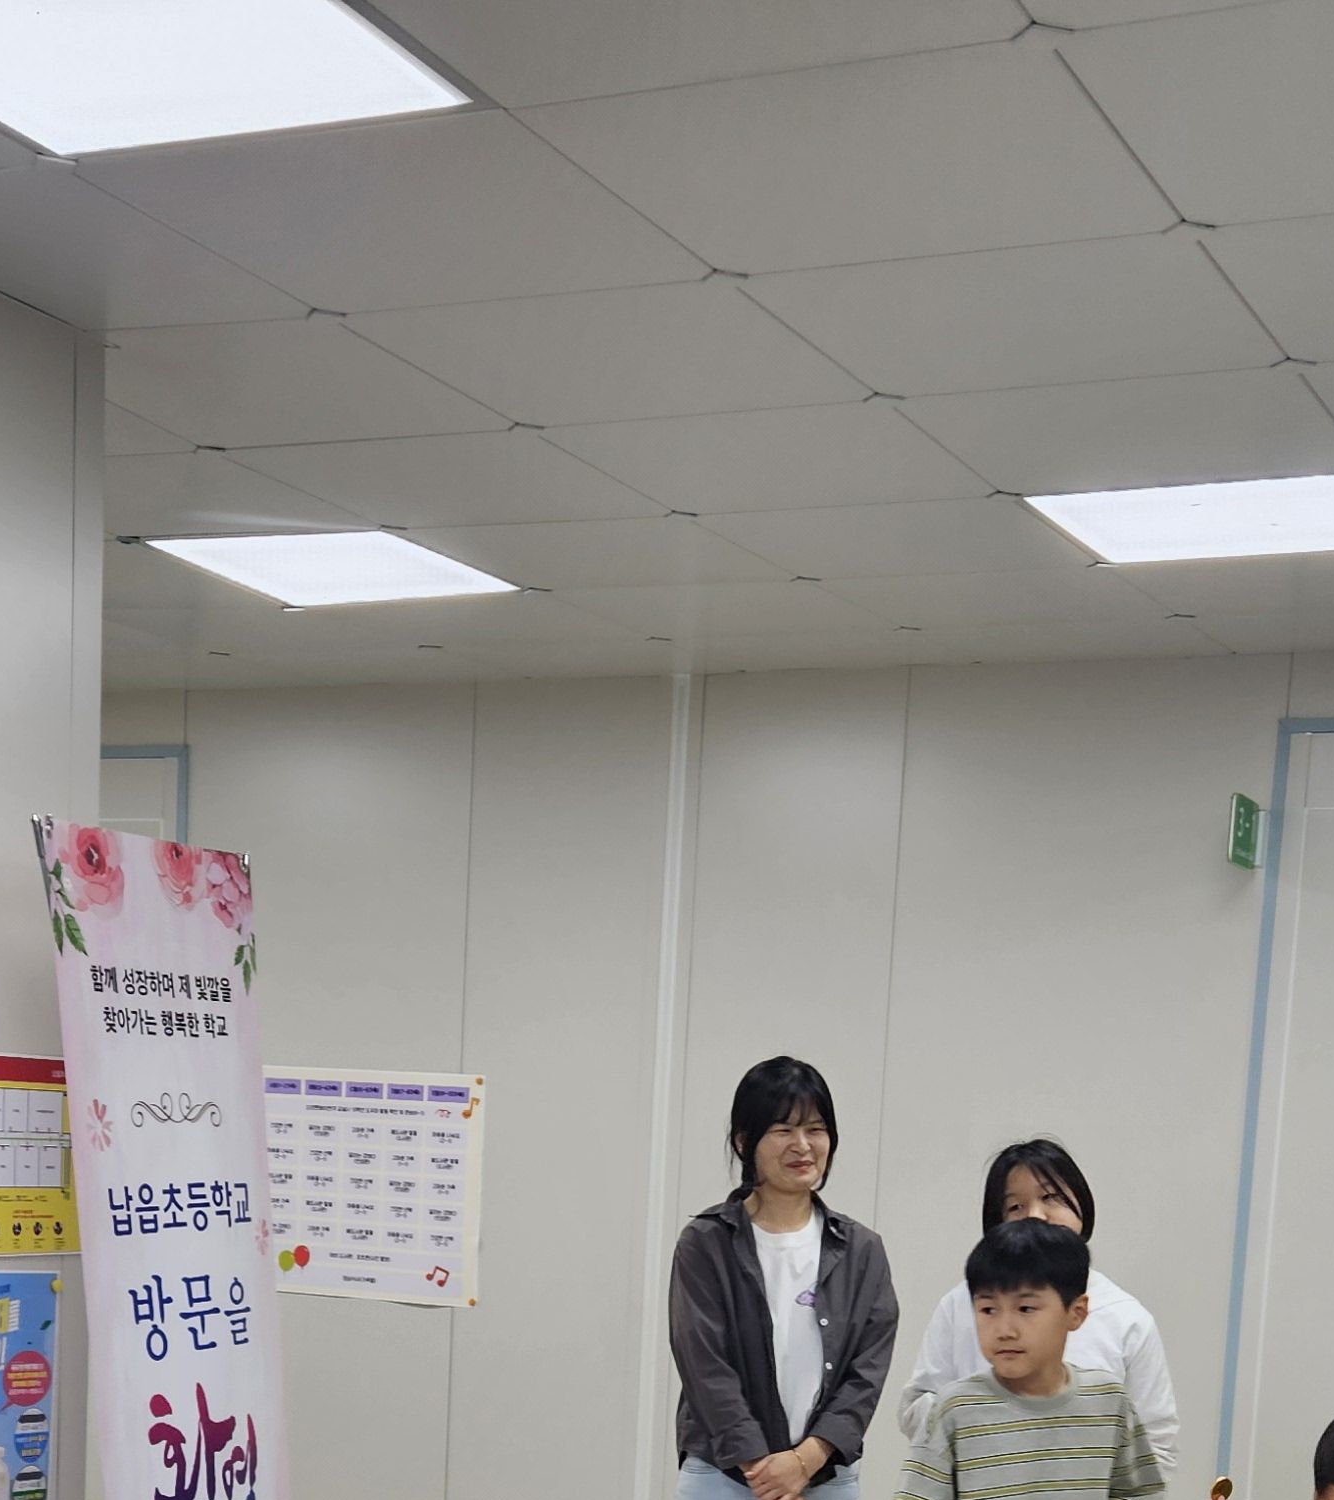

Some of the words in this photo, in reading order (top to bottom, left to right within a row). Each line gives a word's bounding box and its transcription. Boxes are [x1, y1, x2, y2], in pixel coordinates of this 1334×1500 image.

[89, 965, 119, 994] 함께
[121, 968, 175, 999] 성장하며
[178, 974, 192, 1000] 제
[194, 975, 233, 1004] 빛깔을
[102, 1005, 158, 1037] 찾아가는
[160, 1009, 200, 1039] 행복한
[203, 1013, 229, 1039] 학교
[108, 1180, 252, 1237] 납읍초등학교
[128, 1274, 252, 1362] 방문을
